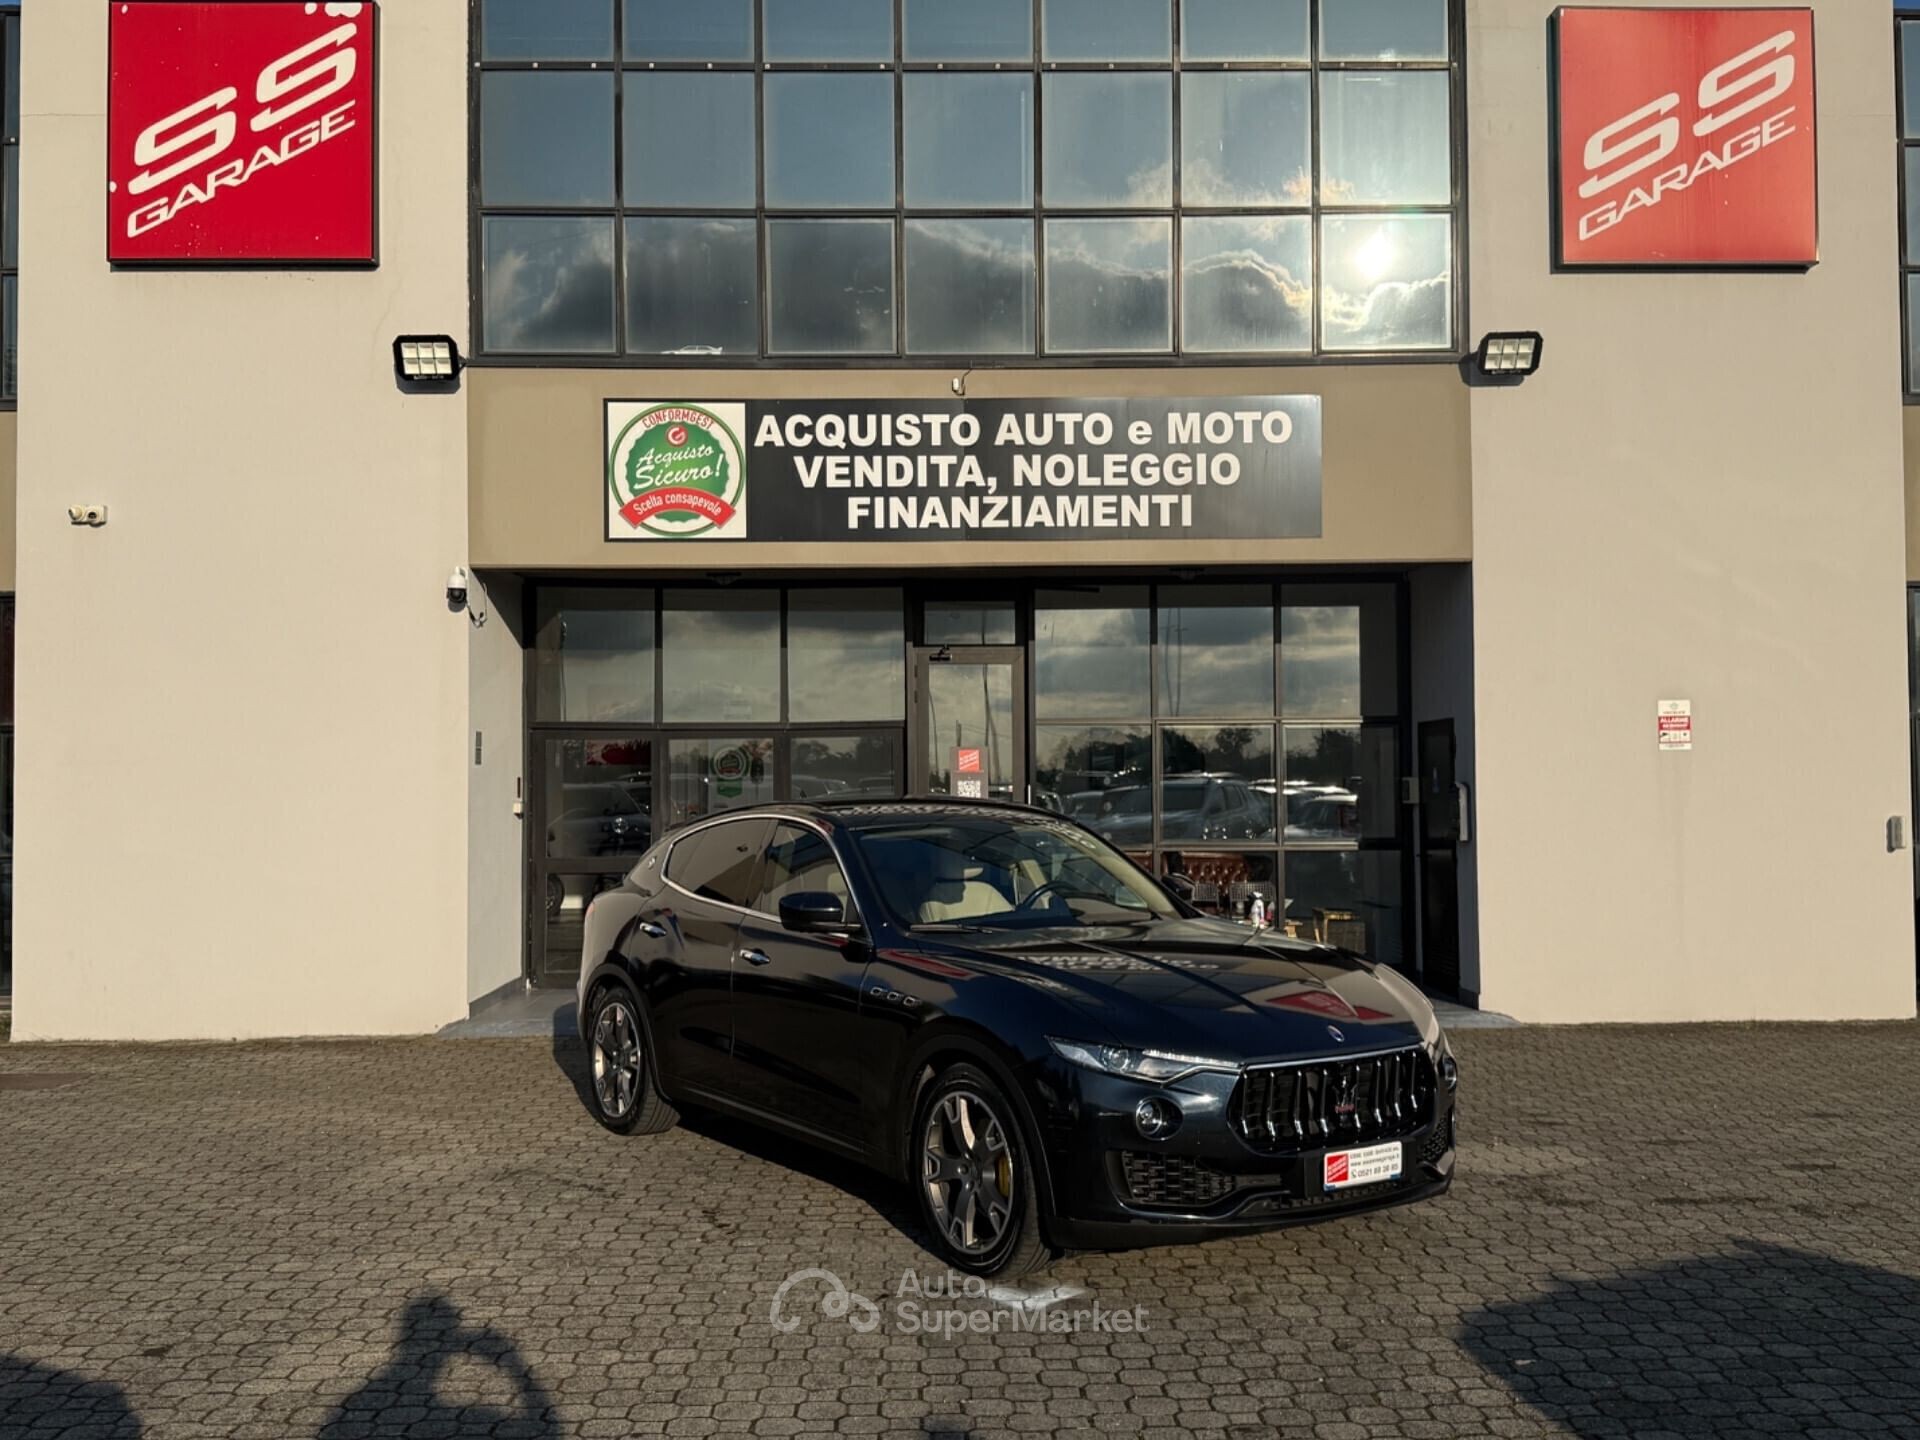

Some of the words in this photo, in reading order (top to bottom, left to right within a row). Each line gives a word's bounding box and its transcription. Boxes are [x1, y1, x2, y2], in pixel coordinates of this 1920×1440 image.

[127, 99, 356, 238] GARAGE
[1579, 105, 1796, 241] GARAGE
[641, 408, 715, 429] CONFORMGEST
[753, 413, 981, 449] ACQUISTO
[994, 412, 1114, 446] AUTO
[1127, 419, 1153, 445] e
[1167, 410, 1293, 445] MOTO
[633, 453, 724, 489] Sicuro!
[636, 443, 714, 468] Acquisto
[793, 453, 998, 494] VENDITA,
[1012, 452, 1241, 487] NOLEGGIO
[632, 494, 664, 515] Scelta
[664, 492, 722, 517] consapevole
[847, 494, 1193, 529] FINANZIAMENTI
